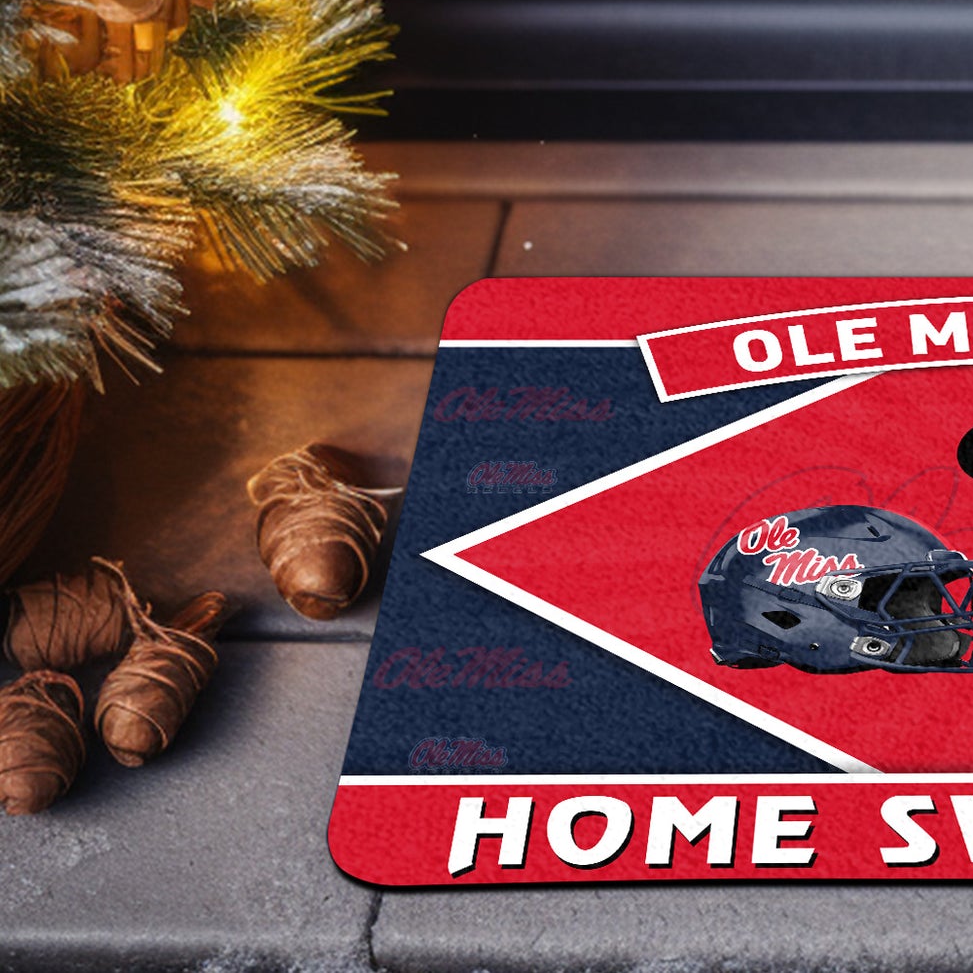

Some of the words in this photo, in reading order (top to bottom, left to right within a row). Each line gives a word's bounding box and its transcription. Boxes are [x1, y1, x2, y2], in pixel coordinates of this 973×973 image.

[732, 316, 884, 373] OLE
[737, 515, 802, 555] Ole
[762, 548, 865, 587] Miss
[447, 795, 818, 876] HOME
